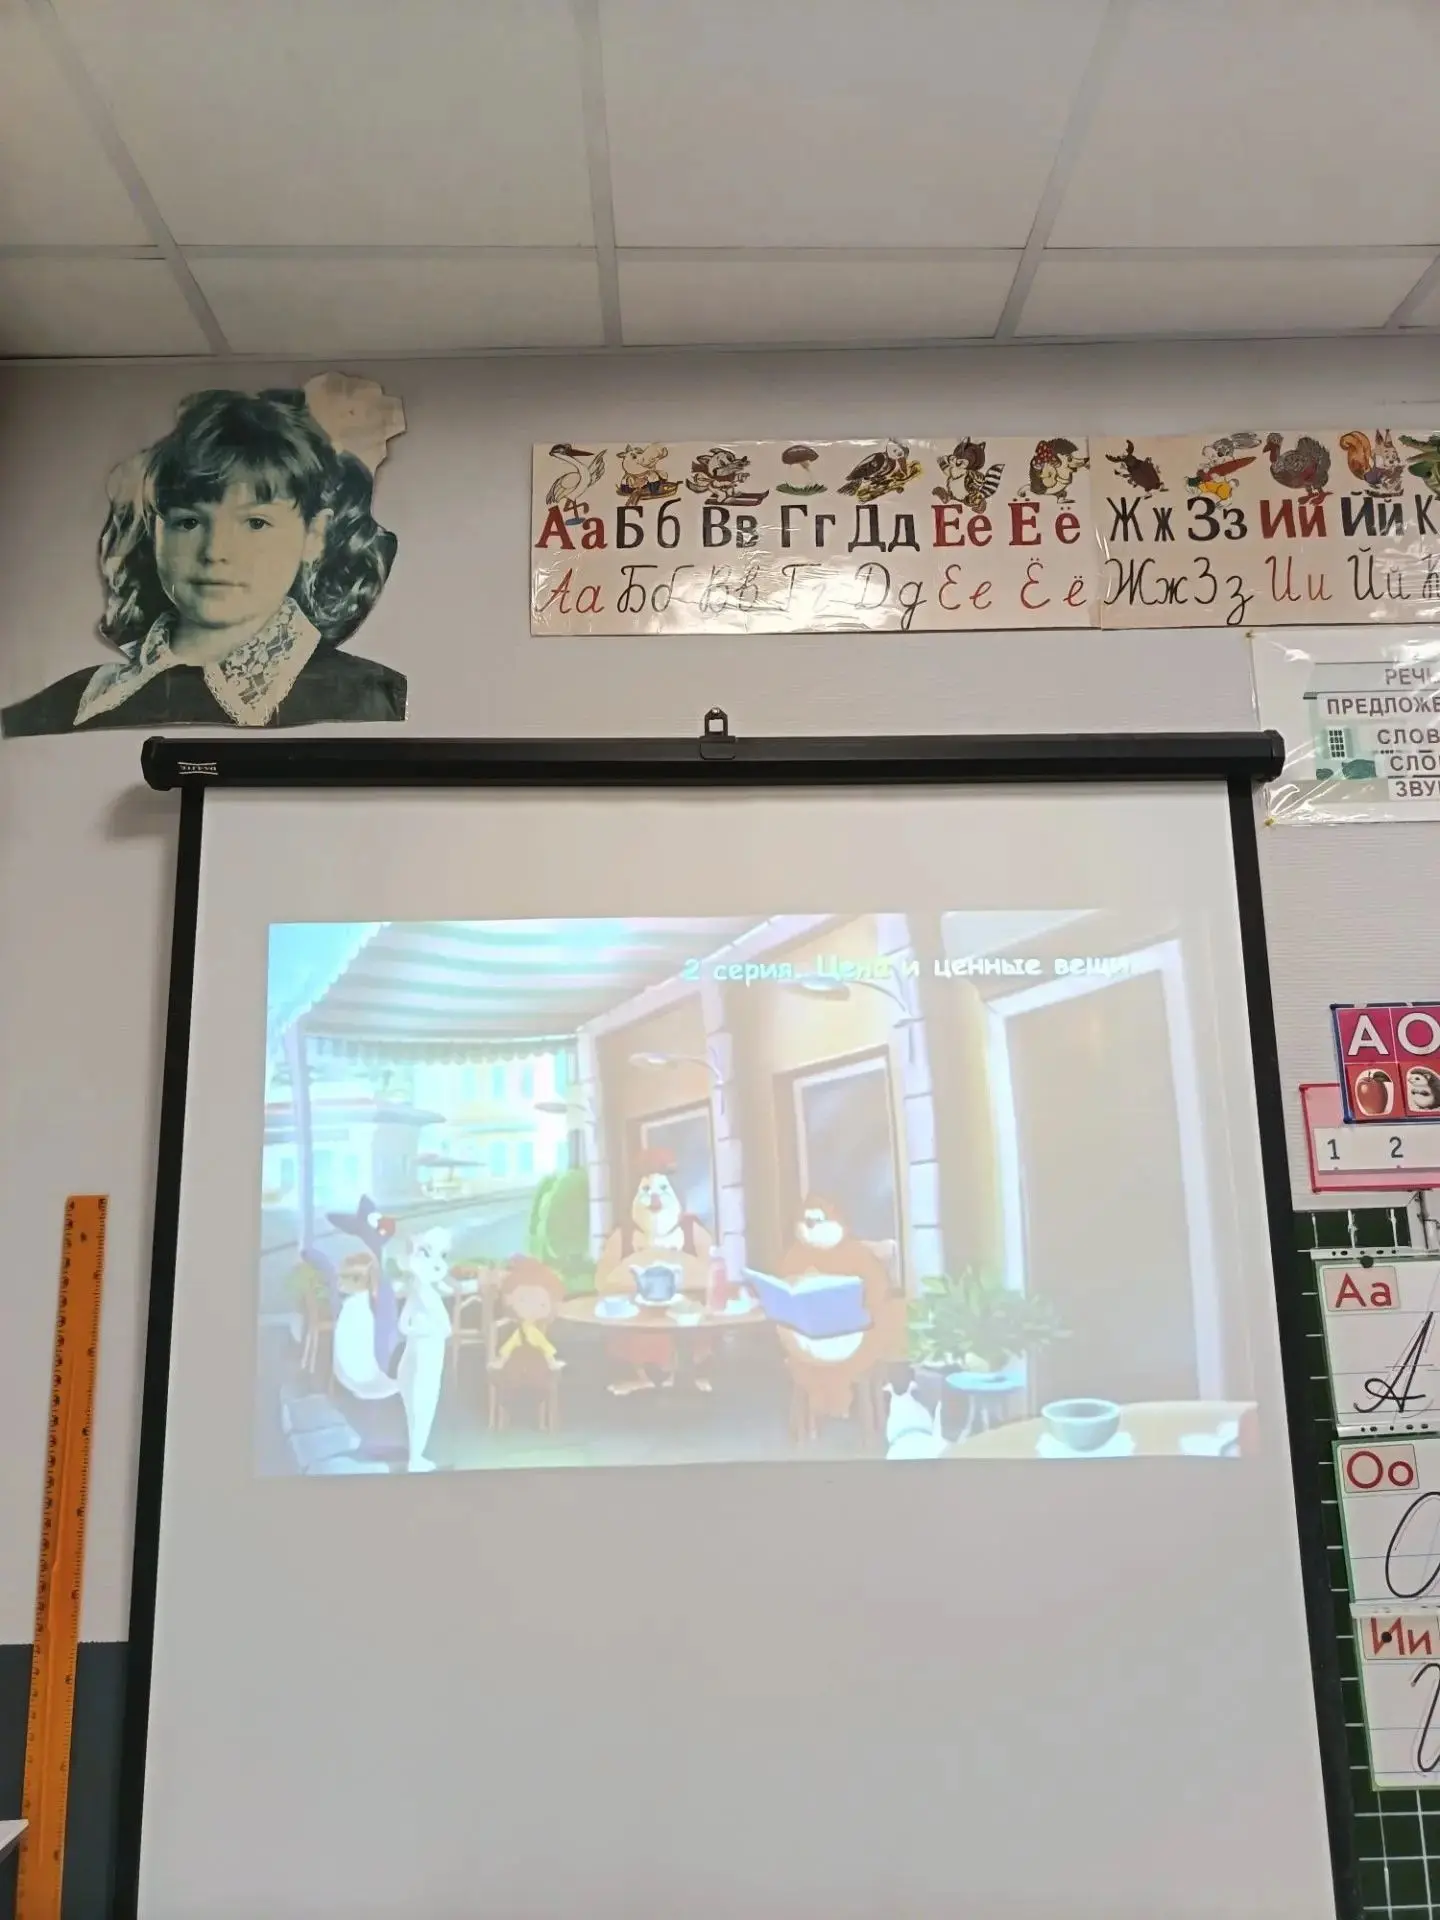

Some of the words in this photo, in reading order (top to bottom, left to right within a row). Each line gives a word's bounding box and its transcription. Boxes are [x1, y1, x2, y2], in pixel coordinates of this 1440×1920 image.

[1390, 755, 1440, 772] СЛО
[1395, 780, 1440, 797] ЗВУ
[683, 957, 701, 982] 2
[815, 954, 896, 980] Цена
[902, 960, 919, 977] и
[933, 957, 1042, 979] ценные
[1327, 1138, 1341, 1160] 1
[1389, 1136, 1404, 1159] 2
[1335, 1272, 1392, 1309] Аа
[1346, 1450, 1414, 1489] Оо
[1369, 1616, 1433, 1656] Ии
